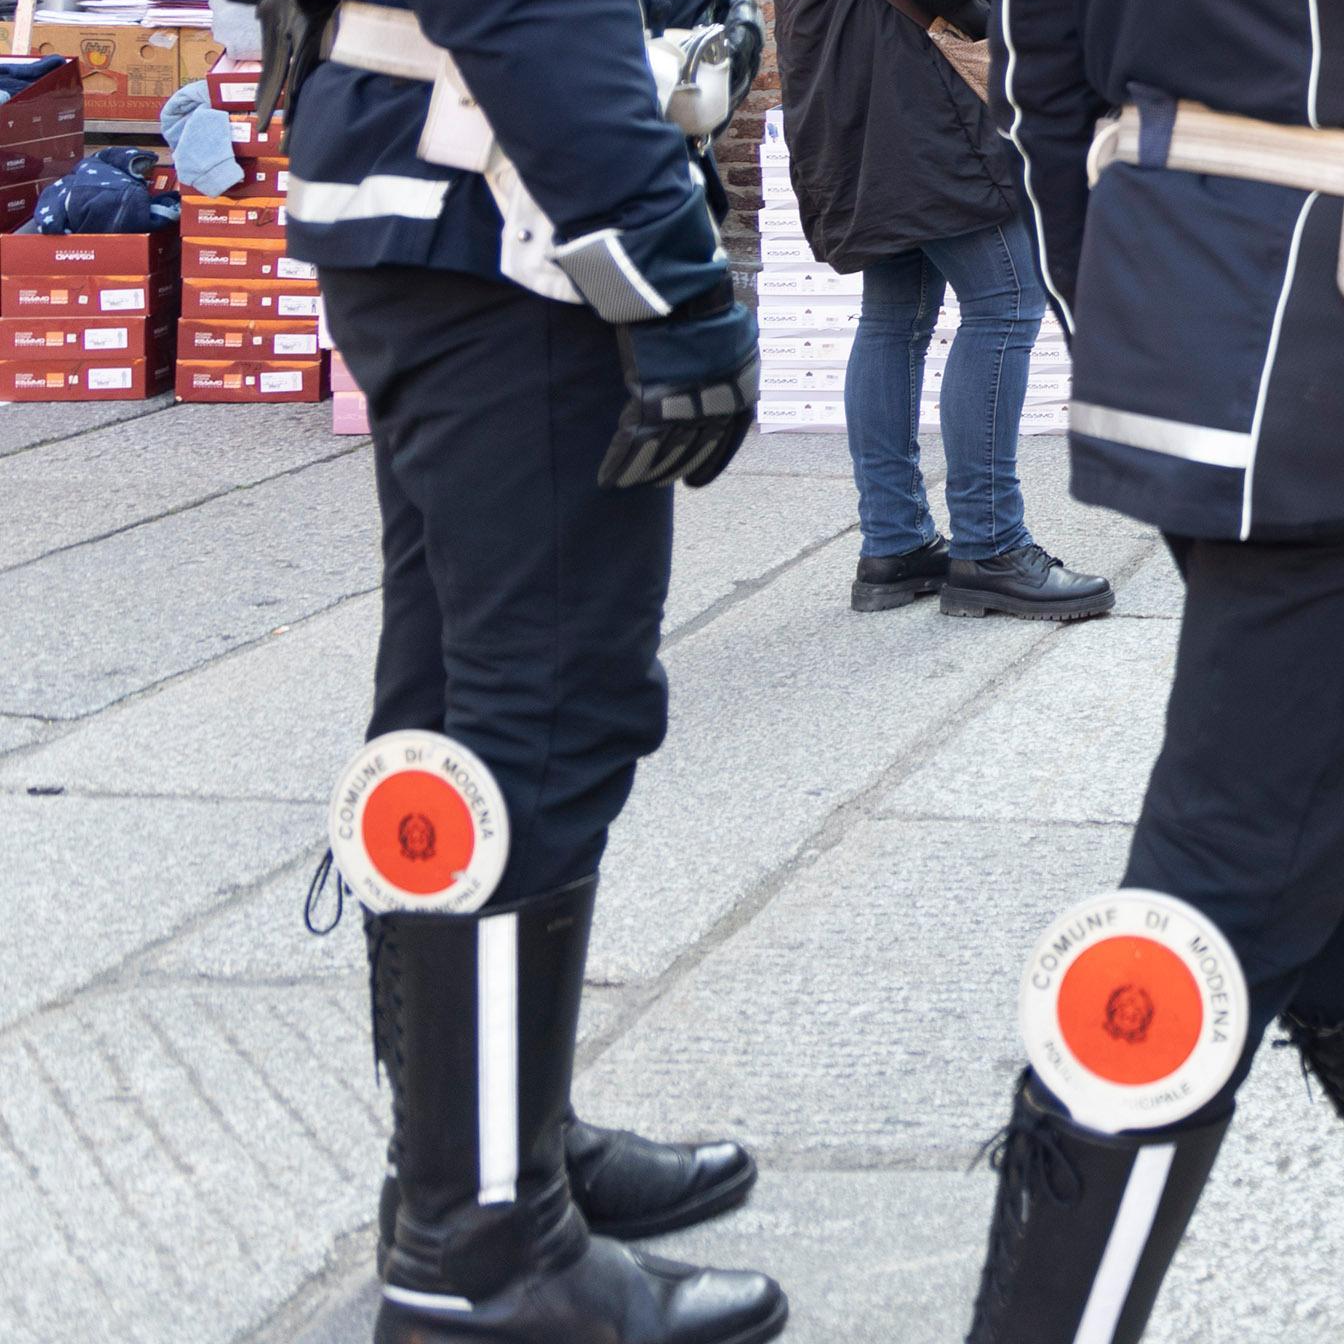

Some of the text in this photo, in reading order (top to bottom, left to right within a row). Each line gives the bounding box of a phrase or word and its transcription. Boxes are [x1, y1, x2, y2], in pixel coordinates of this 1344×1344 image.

[338, 748, 495, 840] COMUNE DI MODENA
[1145, 909, 1170, 932] DI
[1190, 936, 1230, 1044] MODENA
